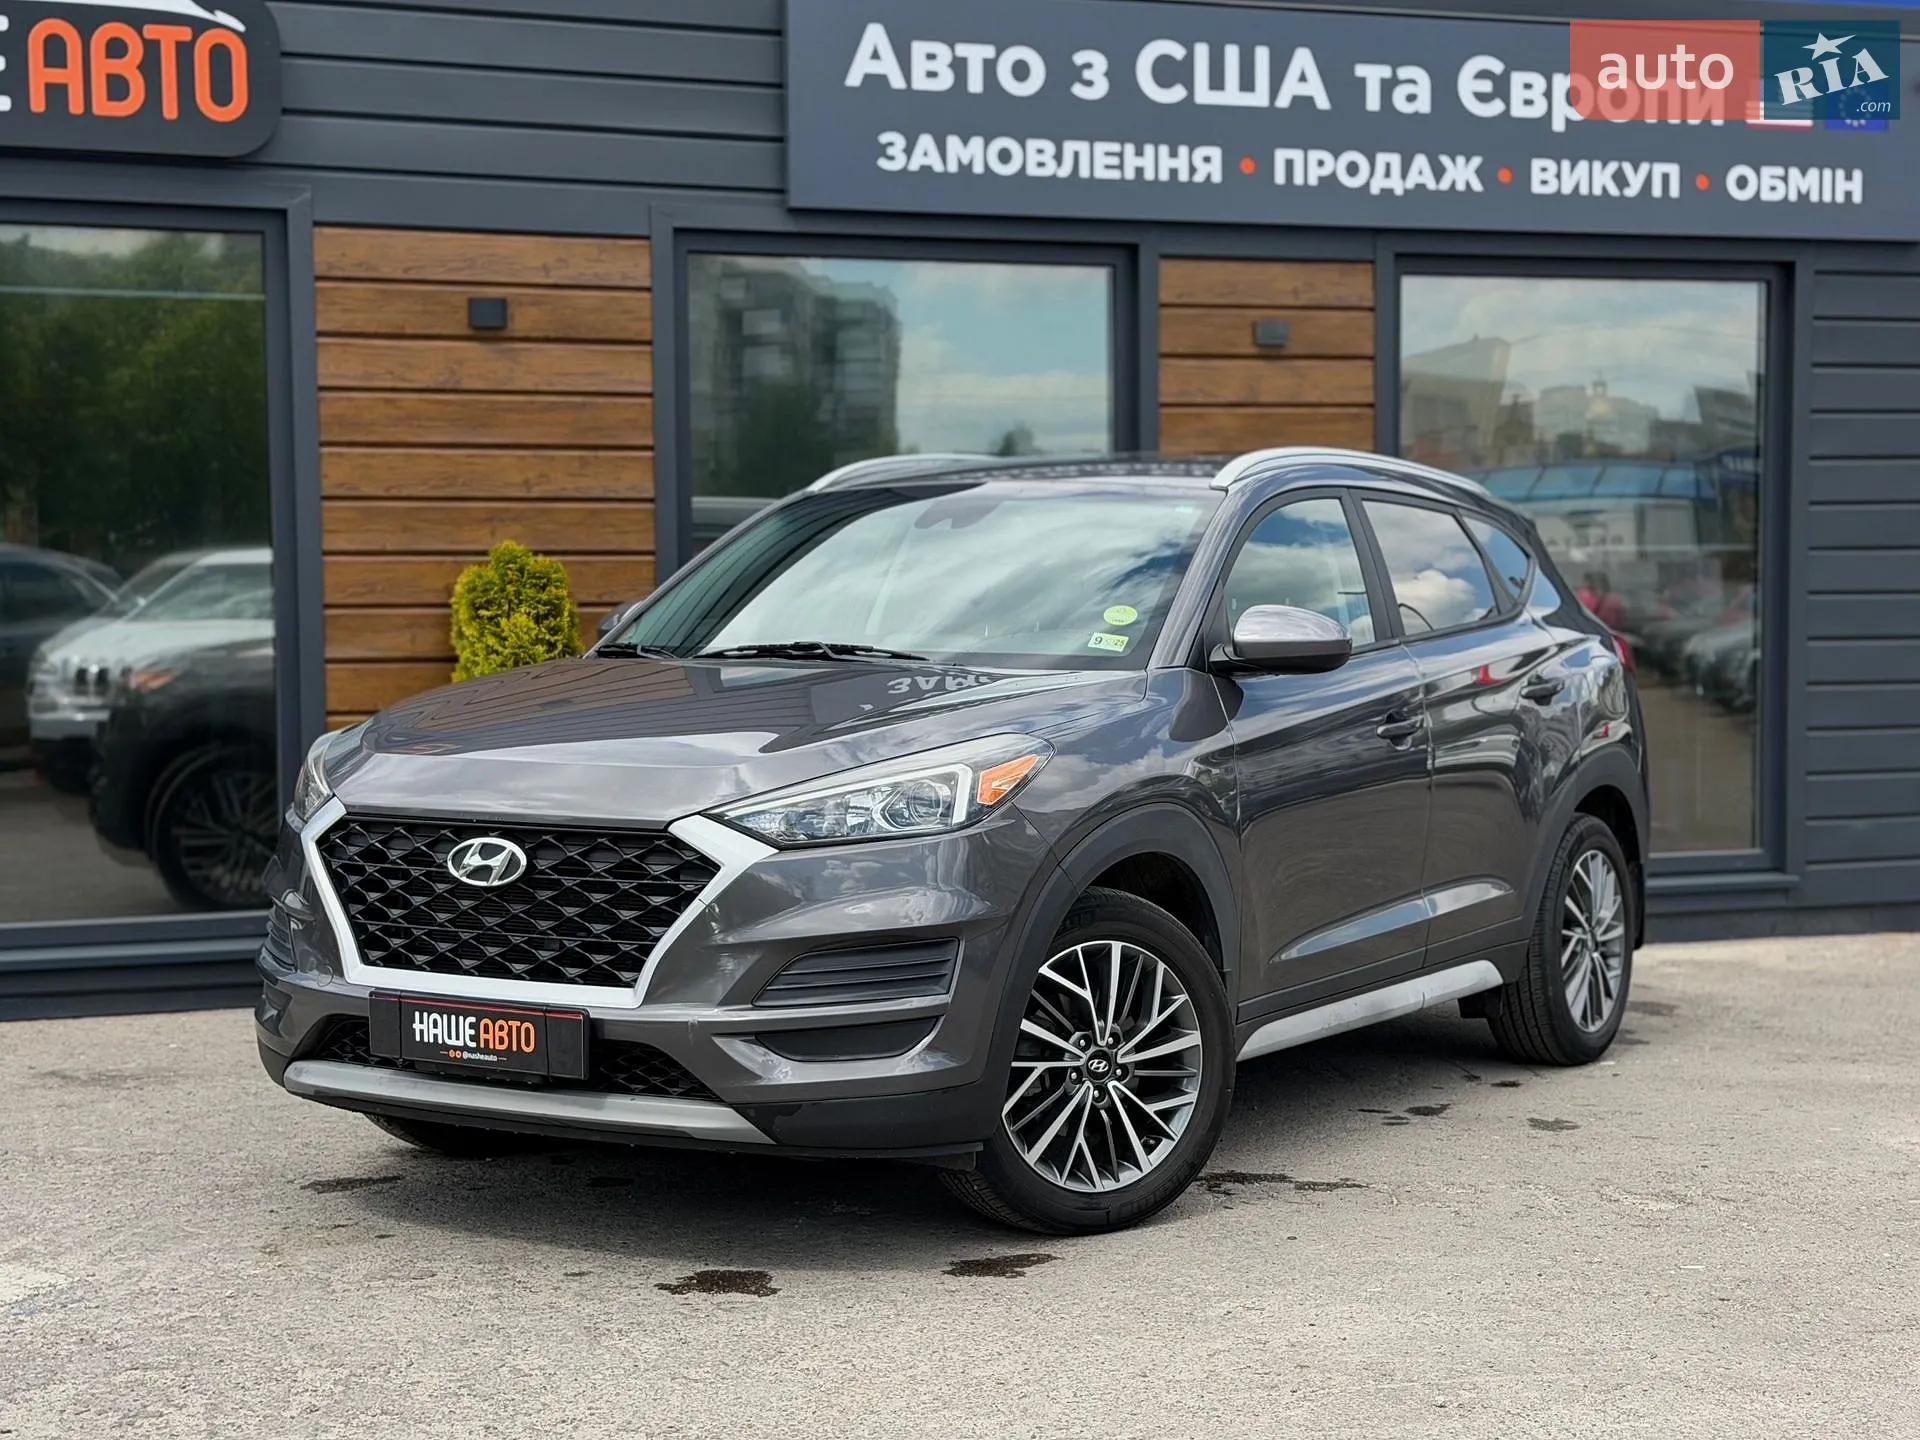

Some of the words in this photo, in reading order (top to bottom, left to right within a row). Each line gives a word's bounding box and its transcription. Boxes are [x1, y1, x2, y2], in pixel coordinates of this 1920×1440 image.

[27, 18, 248, 123] АВТО
[844, 22, 1046, 97] Авто
[1070, 49, 1109, 100] з
[1135, 38, 1331, 111] США
[1353, 62, 1432, 114] та
[876, 131, 1222, 184] ЗАМОВЛЕННЯ
[1273, 147, 1484, 194] ПРОДАЖ
[1530, 158, 1680, 200] ВИКУП
[1725, 164, 1864, 204] ОБМІН
[412, 1011, 476, 1048] НАШЕ
[479, 1018, 535, 1053] АВТО
